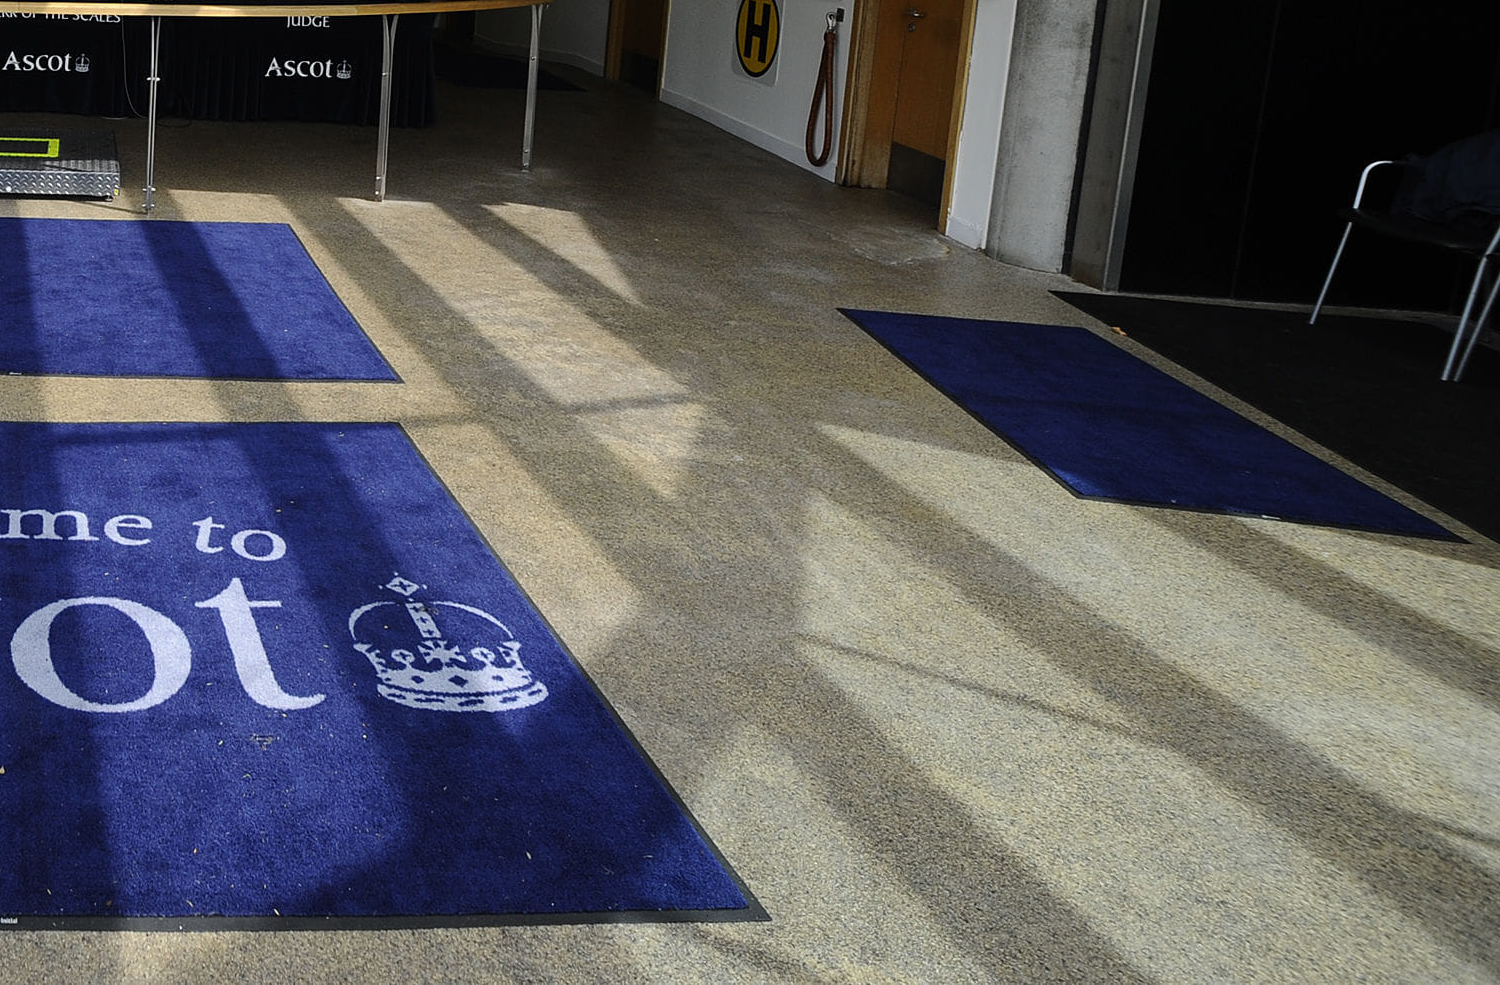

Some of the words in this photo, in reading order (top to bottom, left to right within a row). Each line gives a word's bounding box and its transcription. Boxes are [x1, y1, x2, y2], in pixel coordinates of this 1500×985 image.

[286, 15, 331, 29] JUDGE
[744, 0, 771, 63] H
[193, 515, 287, 561] to
